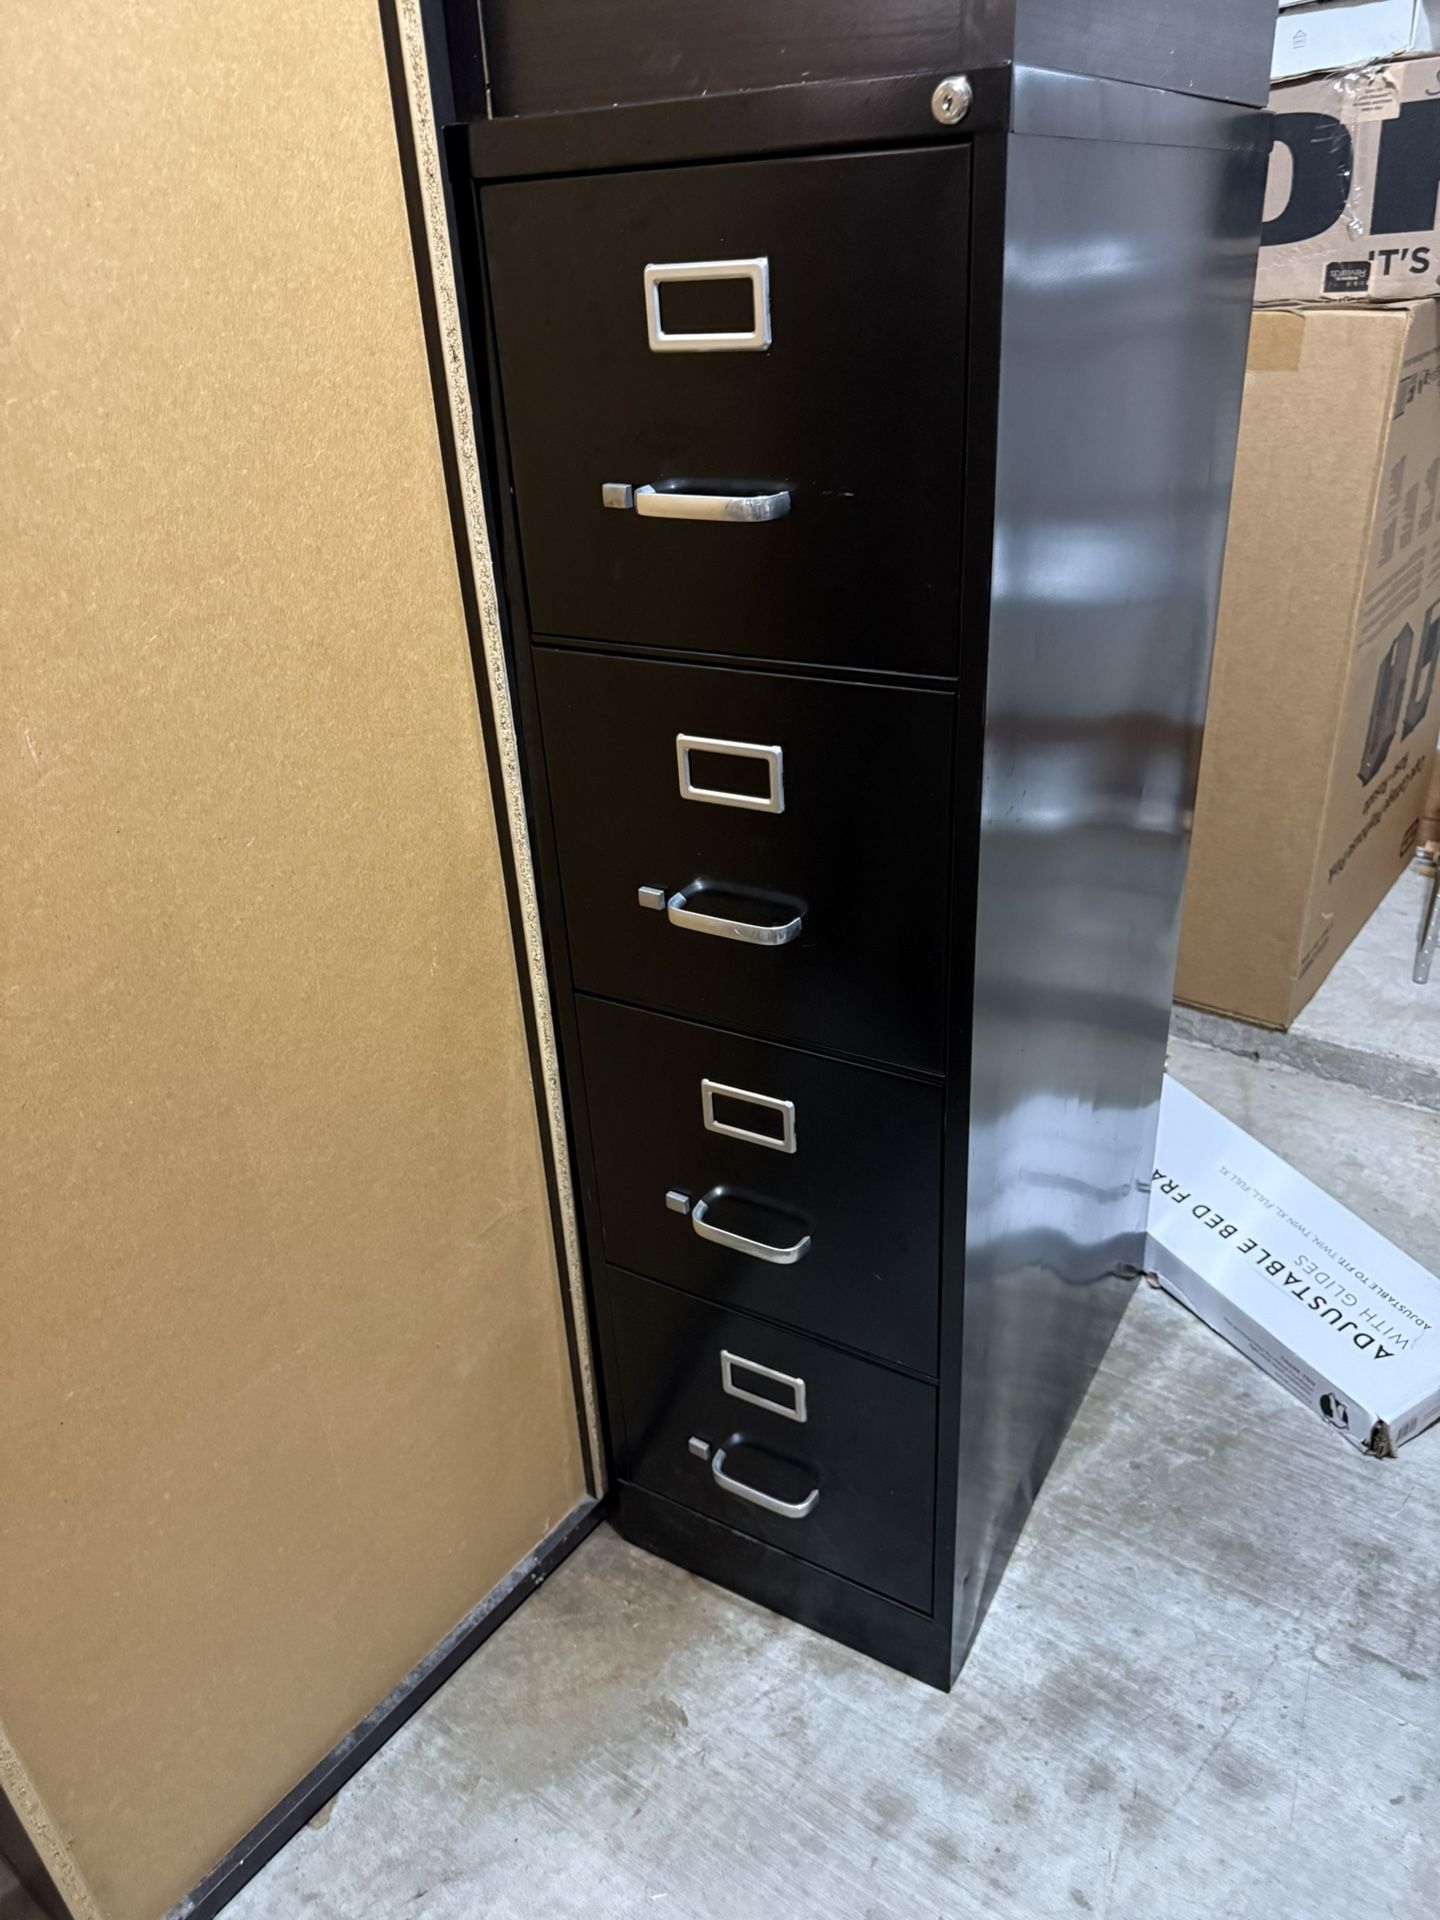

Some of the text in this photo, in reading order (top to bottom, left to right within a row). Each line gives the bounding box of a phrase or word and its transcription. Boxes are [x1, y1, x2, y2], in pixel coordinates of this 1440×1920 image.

[1230, 1174, 1251, 1192] FULL
[1192, 1204, 1238, 1239] BED
[1286, 1217, 1311, 1238] TWIN
[1354, 1271, 1369, 1285] TO
[1236, 1237, 1395, 1360] ADJUSTABLE
[1294, 1254, 1409, 1350] WITH GLIDES
[1369, 1281, 1432, 1330] ADJUSTABLE
